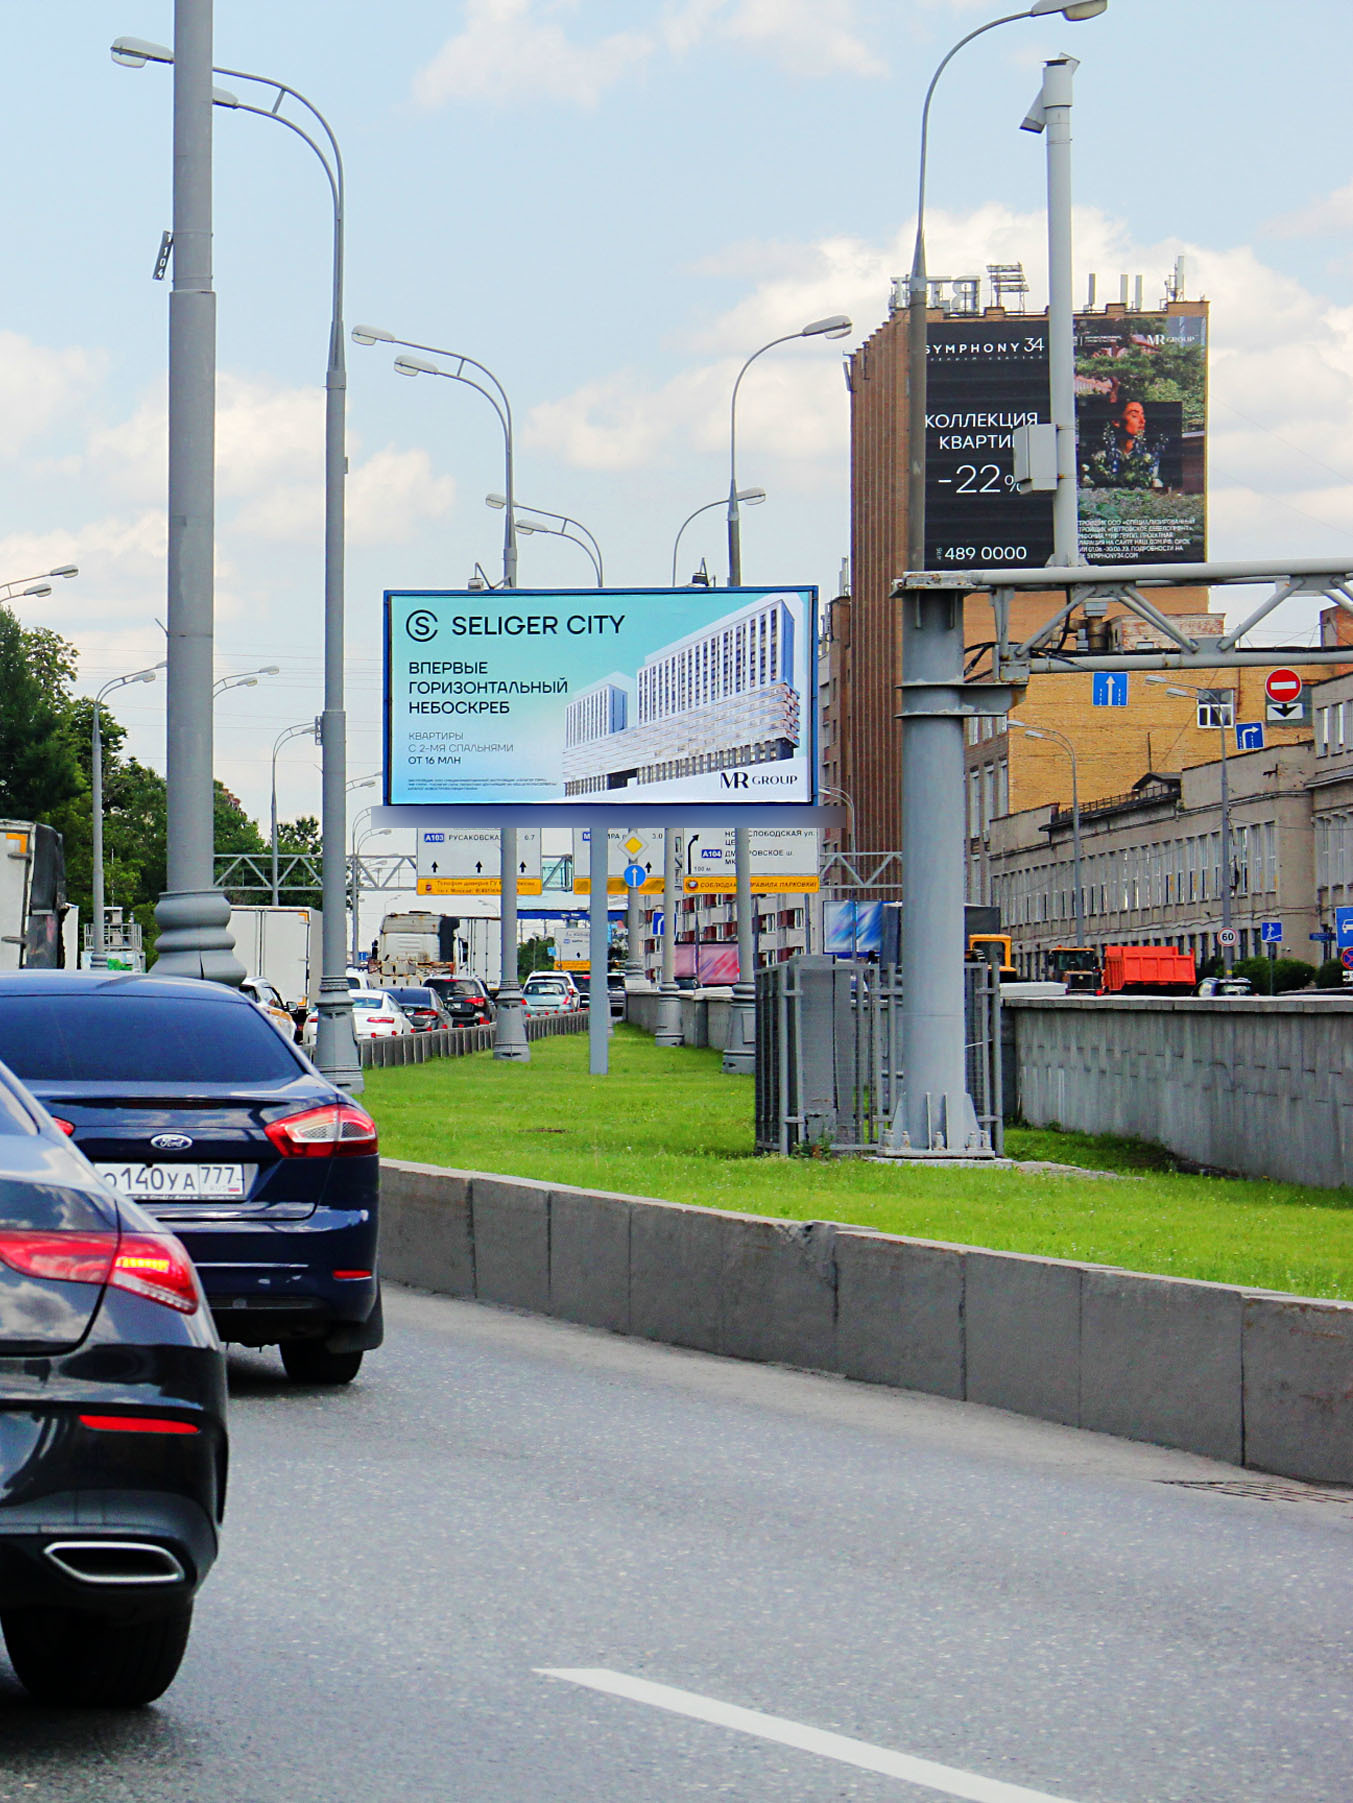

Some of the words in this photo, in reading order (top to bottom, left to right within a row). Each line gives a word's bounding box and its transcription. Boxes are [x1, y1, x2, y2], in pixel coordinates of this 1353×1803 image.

[1024, 337, 1045, 352] 34
[925, 412, 1038, 429] КОЛЛЕКЦИЯ
[939, 434, 1014, 450] КВАРТИ
[944, 547, 976, 560] 489
[981, 546, 1027, 560] 0000
[452, 616, 558, 636] SELIGER
[566, 615, 626, 634] CITY
[408, 662, 488, 674] ВПЕРВЫЕ
[408, 676, 568, 694] ГОРИЗОНТАЛЬНЫЙ
[408, 701, 510, 714] НЕБОСКРЕБ
[408, 732, 464, 740] КВАРТИРЫ
[408, 744, 416, 752] С
[419, 744, 446, 752] 2-МЯ
[449, 744, 514, 752] СПАЛЬНЯМИ
[408, 756, 422, 764] ОТ
[426, 756, 435, 764] 16
[438, 756, 462, 764] МЛН
[720, 772, 749, 789] MR
[752, 775, 798, 785] GROUP
[1222, 932, 1234, 940] 60
[160, 1138, 183, 1148] Ford
[201, 1166, 235, 1184] 777
